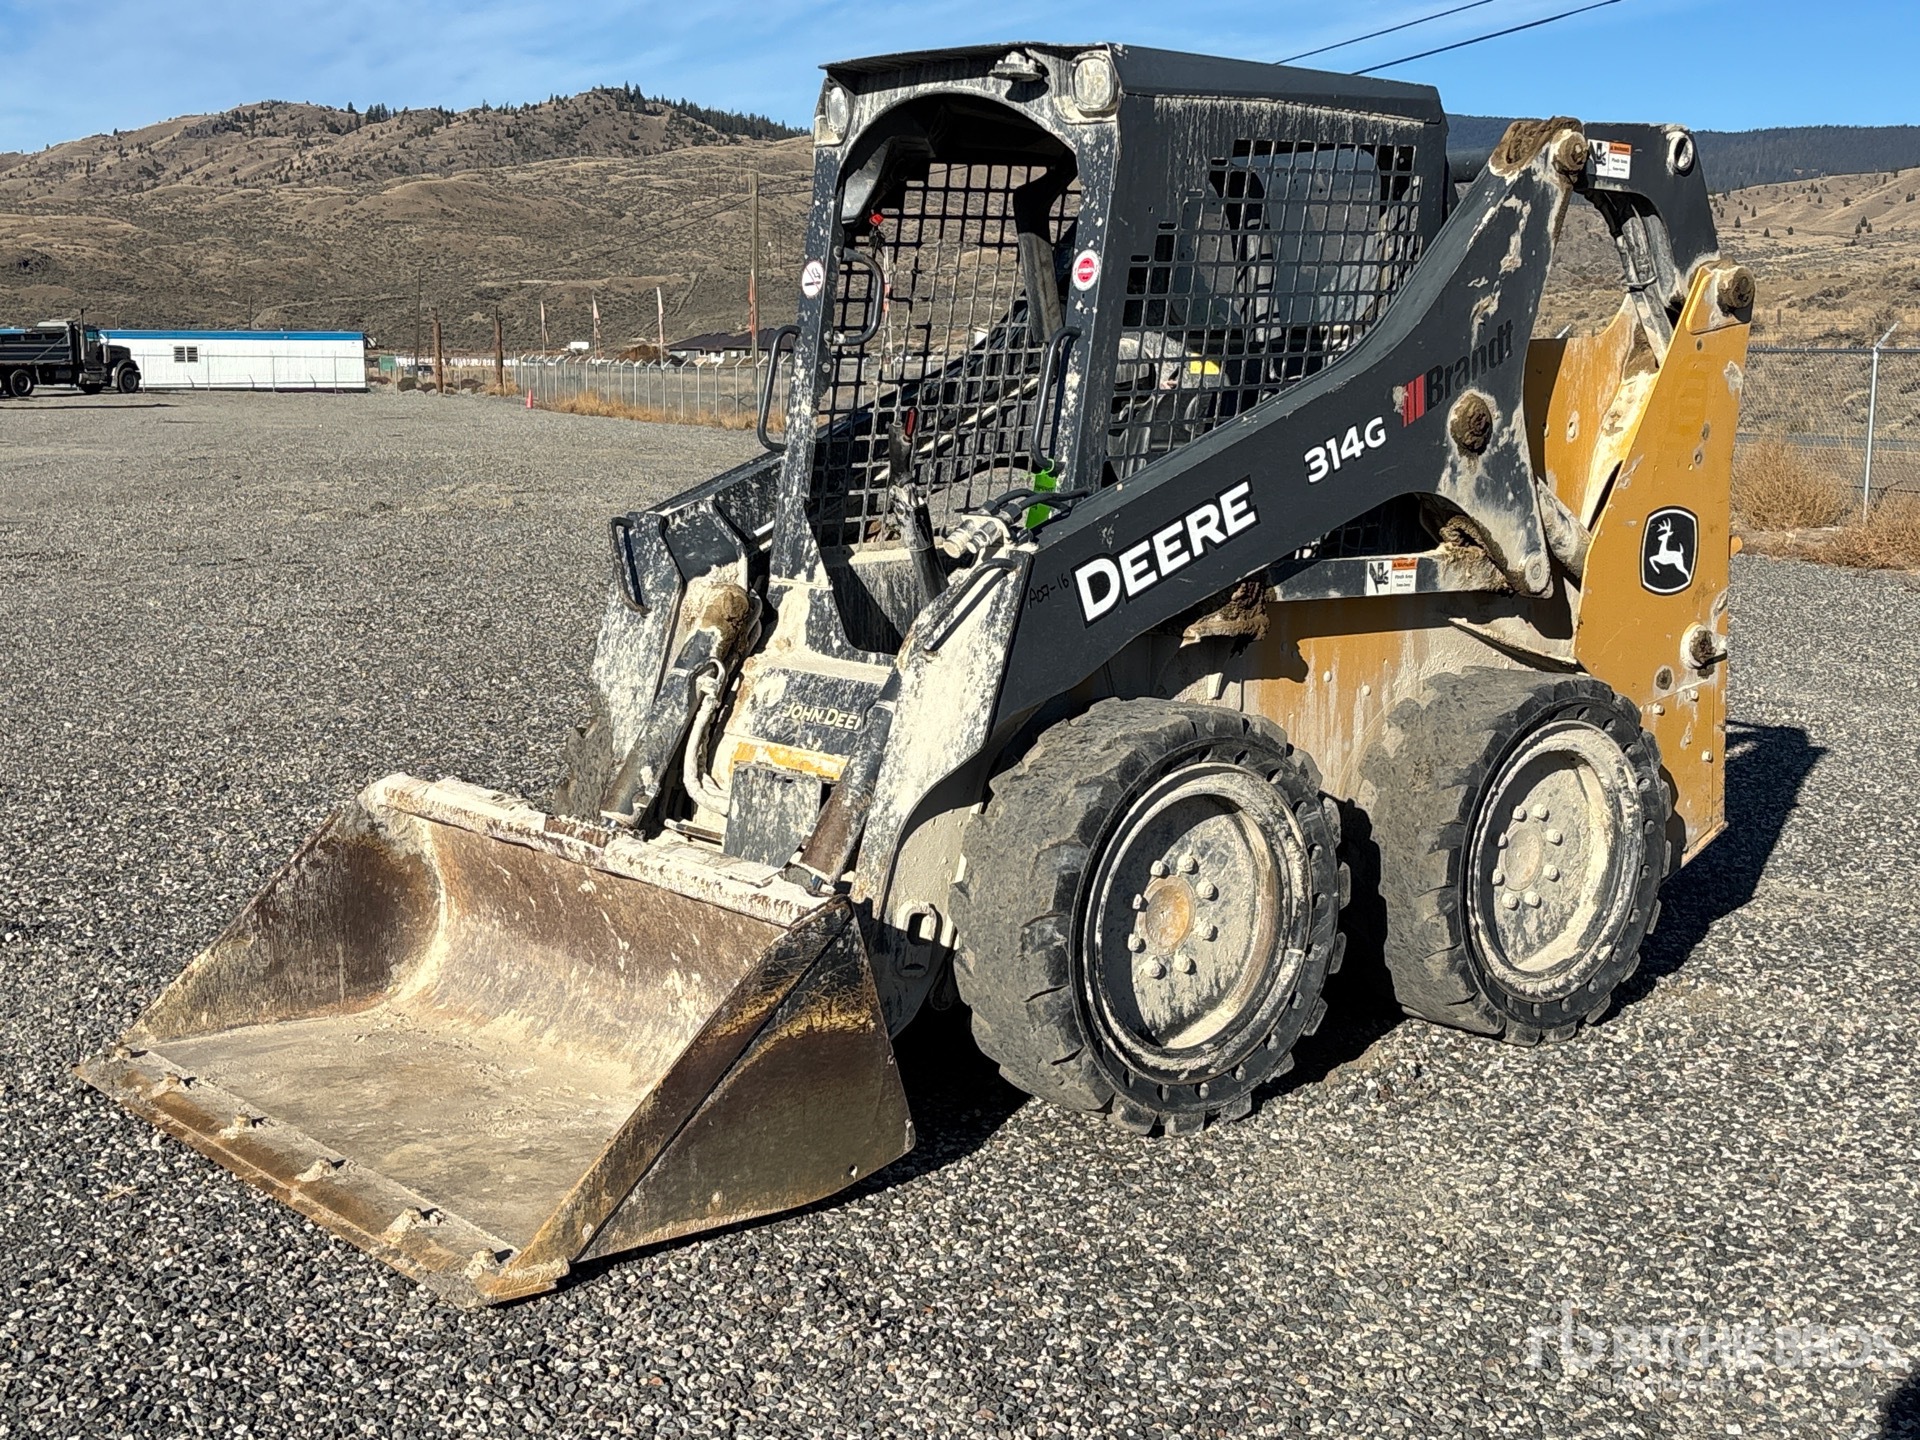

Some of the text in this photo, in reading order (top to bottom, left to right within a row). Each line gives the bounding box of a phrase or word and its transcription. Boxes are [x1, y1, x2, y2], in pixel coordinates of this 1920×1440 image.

[1426, 319, 1514, 412] Brandt
[1304, 416, 1387, 483] 314G
[1073, 480, 1258, 623] DEERE
[783, 703, 862, 731] JOHN DEE
